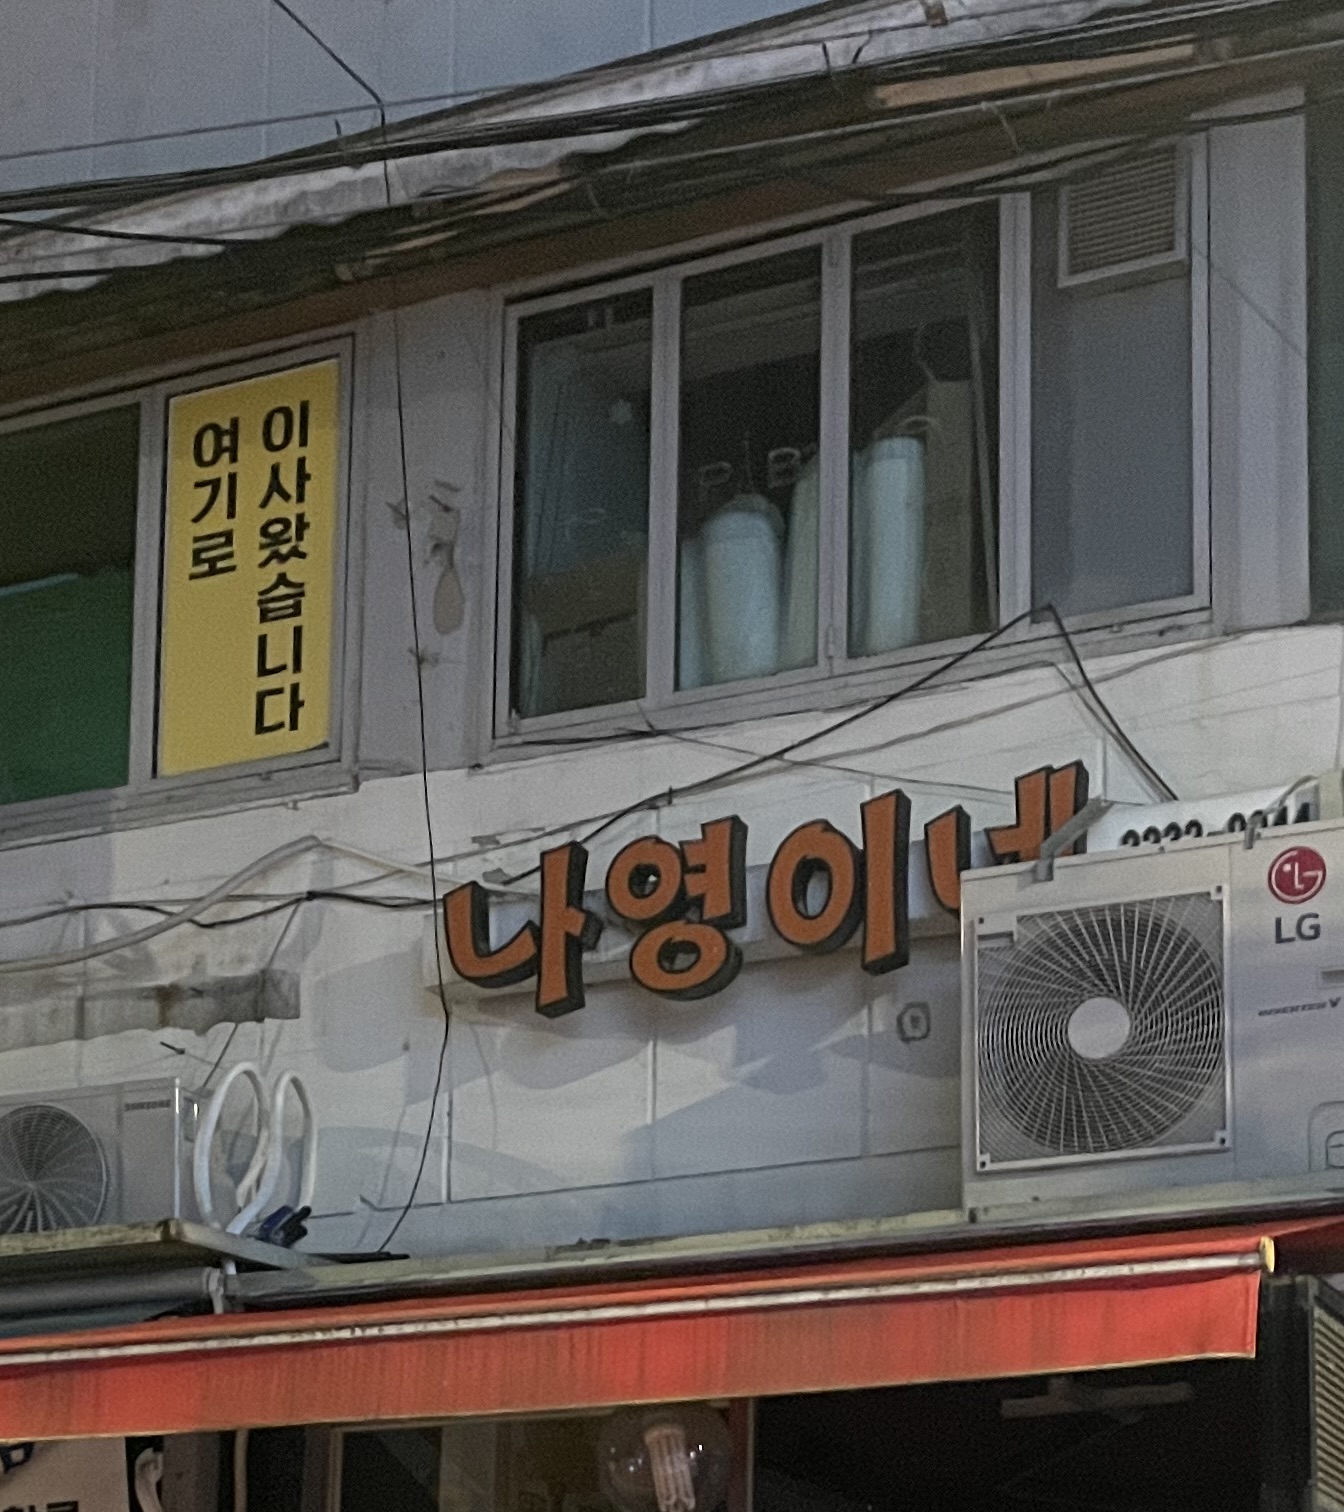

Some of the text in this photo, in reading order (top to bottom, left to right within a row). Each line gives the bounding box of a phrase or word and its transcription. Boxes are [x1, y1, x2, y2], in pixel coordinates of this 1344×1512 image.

[187, 416, 240, 582] 여기로
[254, 400, 312, 736] 이사왔습니다
[1274, 912, 1321, 944] LG
